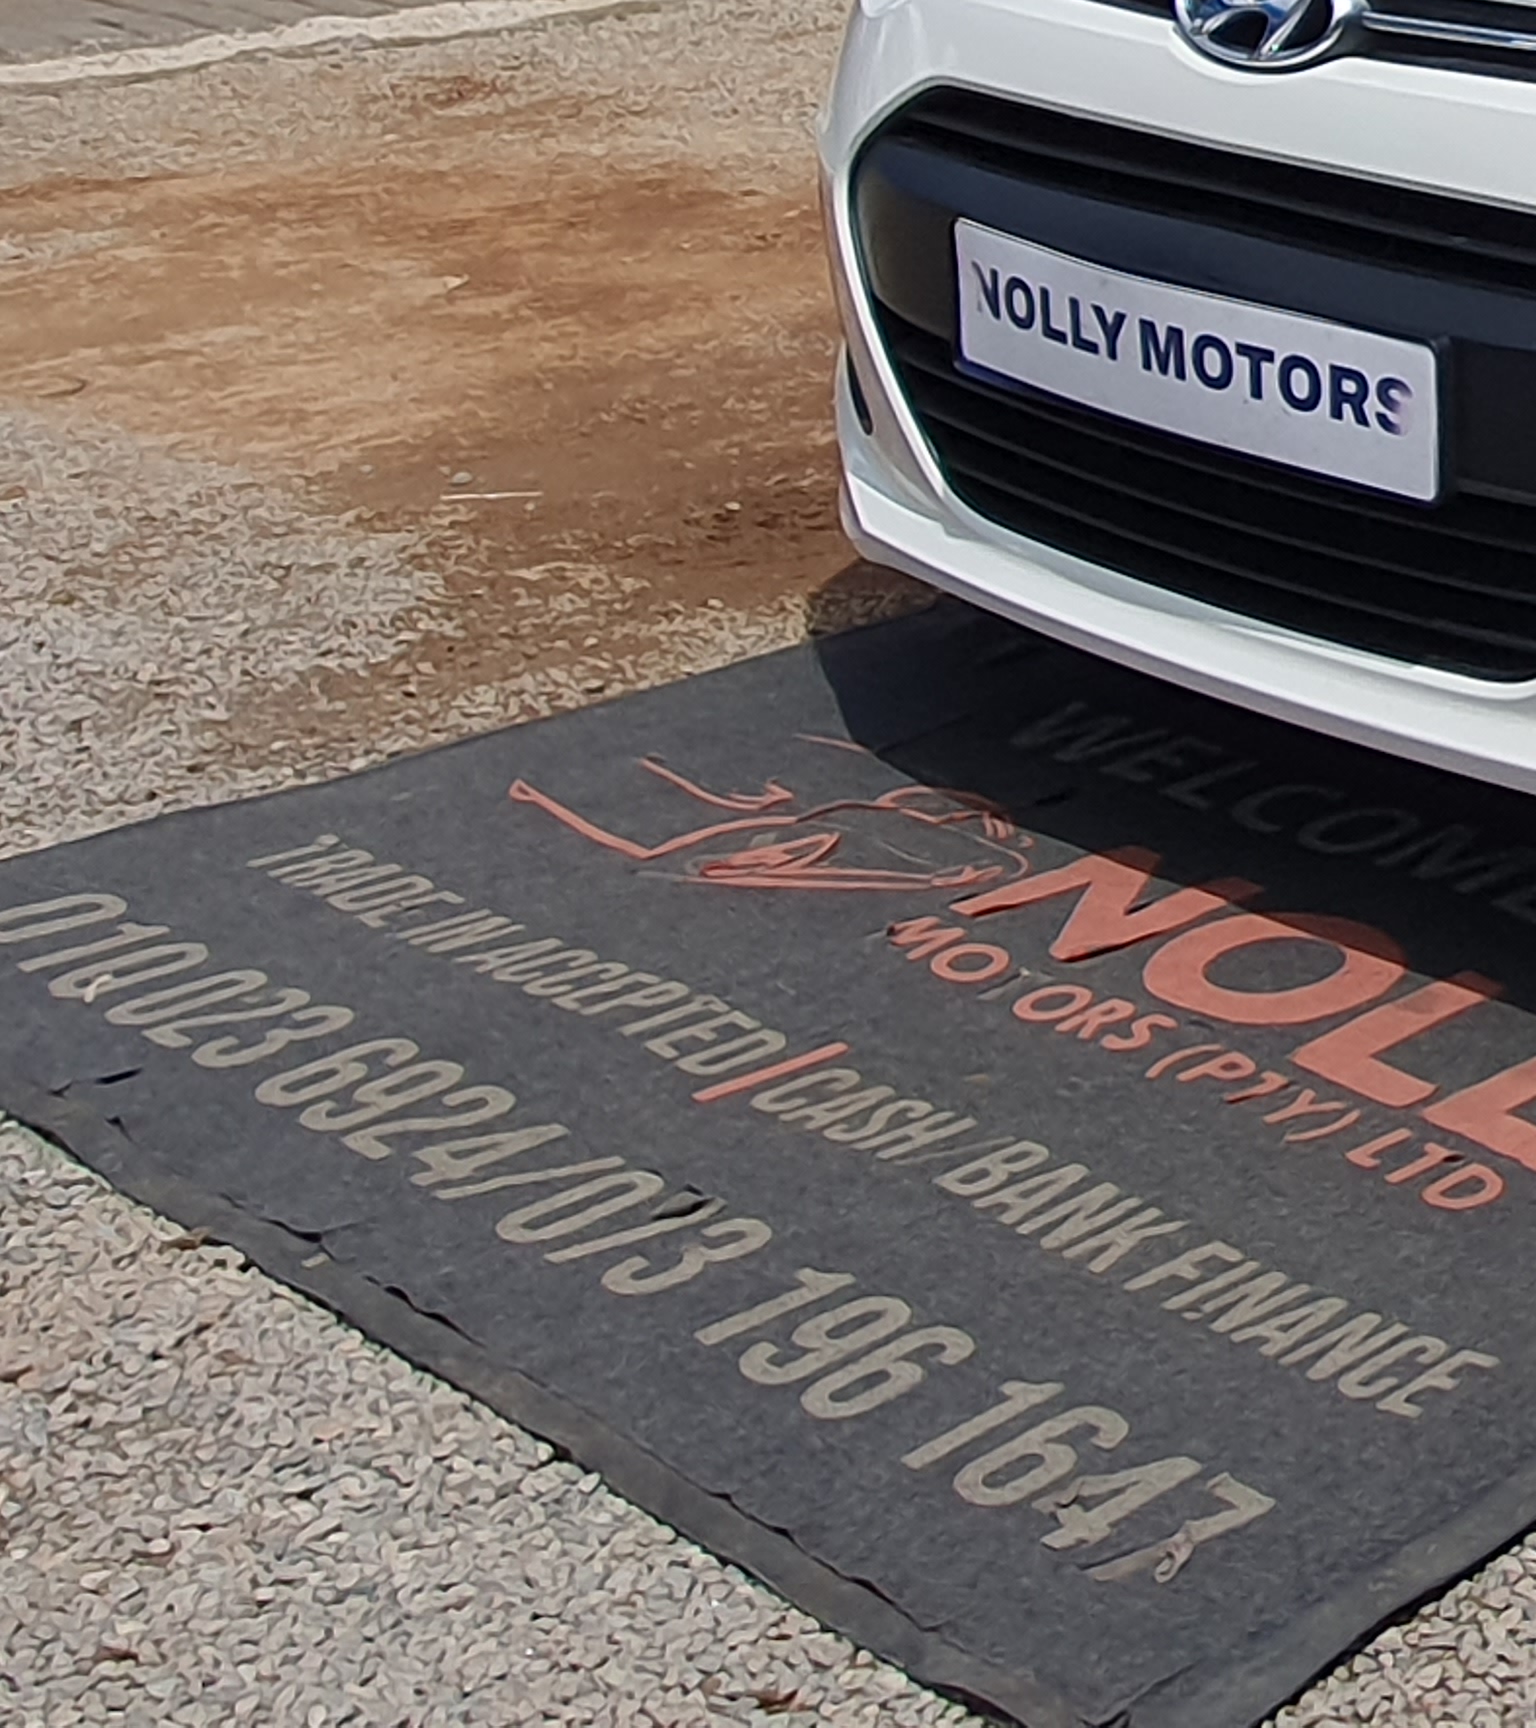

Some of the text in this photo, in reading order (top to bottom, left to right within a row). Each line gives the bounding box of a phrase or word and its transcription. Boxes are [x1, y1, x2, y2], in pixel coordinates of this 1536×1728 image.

[971, 260, 1414, 436] NOLLY MOTORS
[246, 834, 466, 929] TRADE
[397, 908, 526, 953] IN
[453, 937, 788, 1075] ACCEPTED
[1345, 1127, 1505, 1212] LTD
[1122, 1239, 1501, 1419] FINANCE
[693, 1267, 977, 1420] 196
[900, 1379, 1277, 1582] 1647
